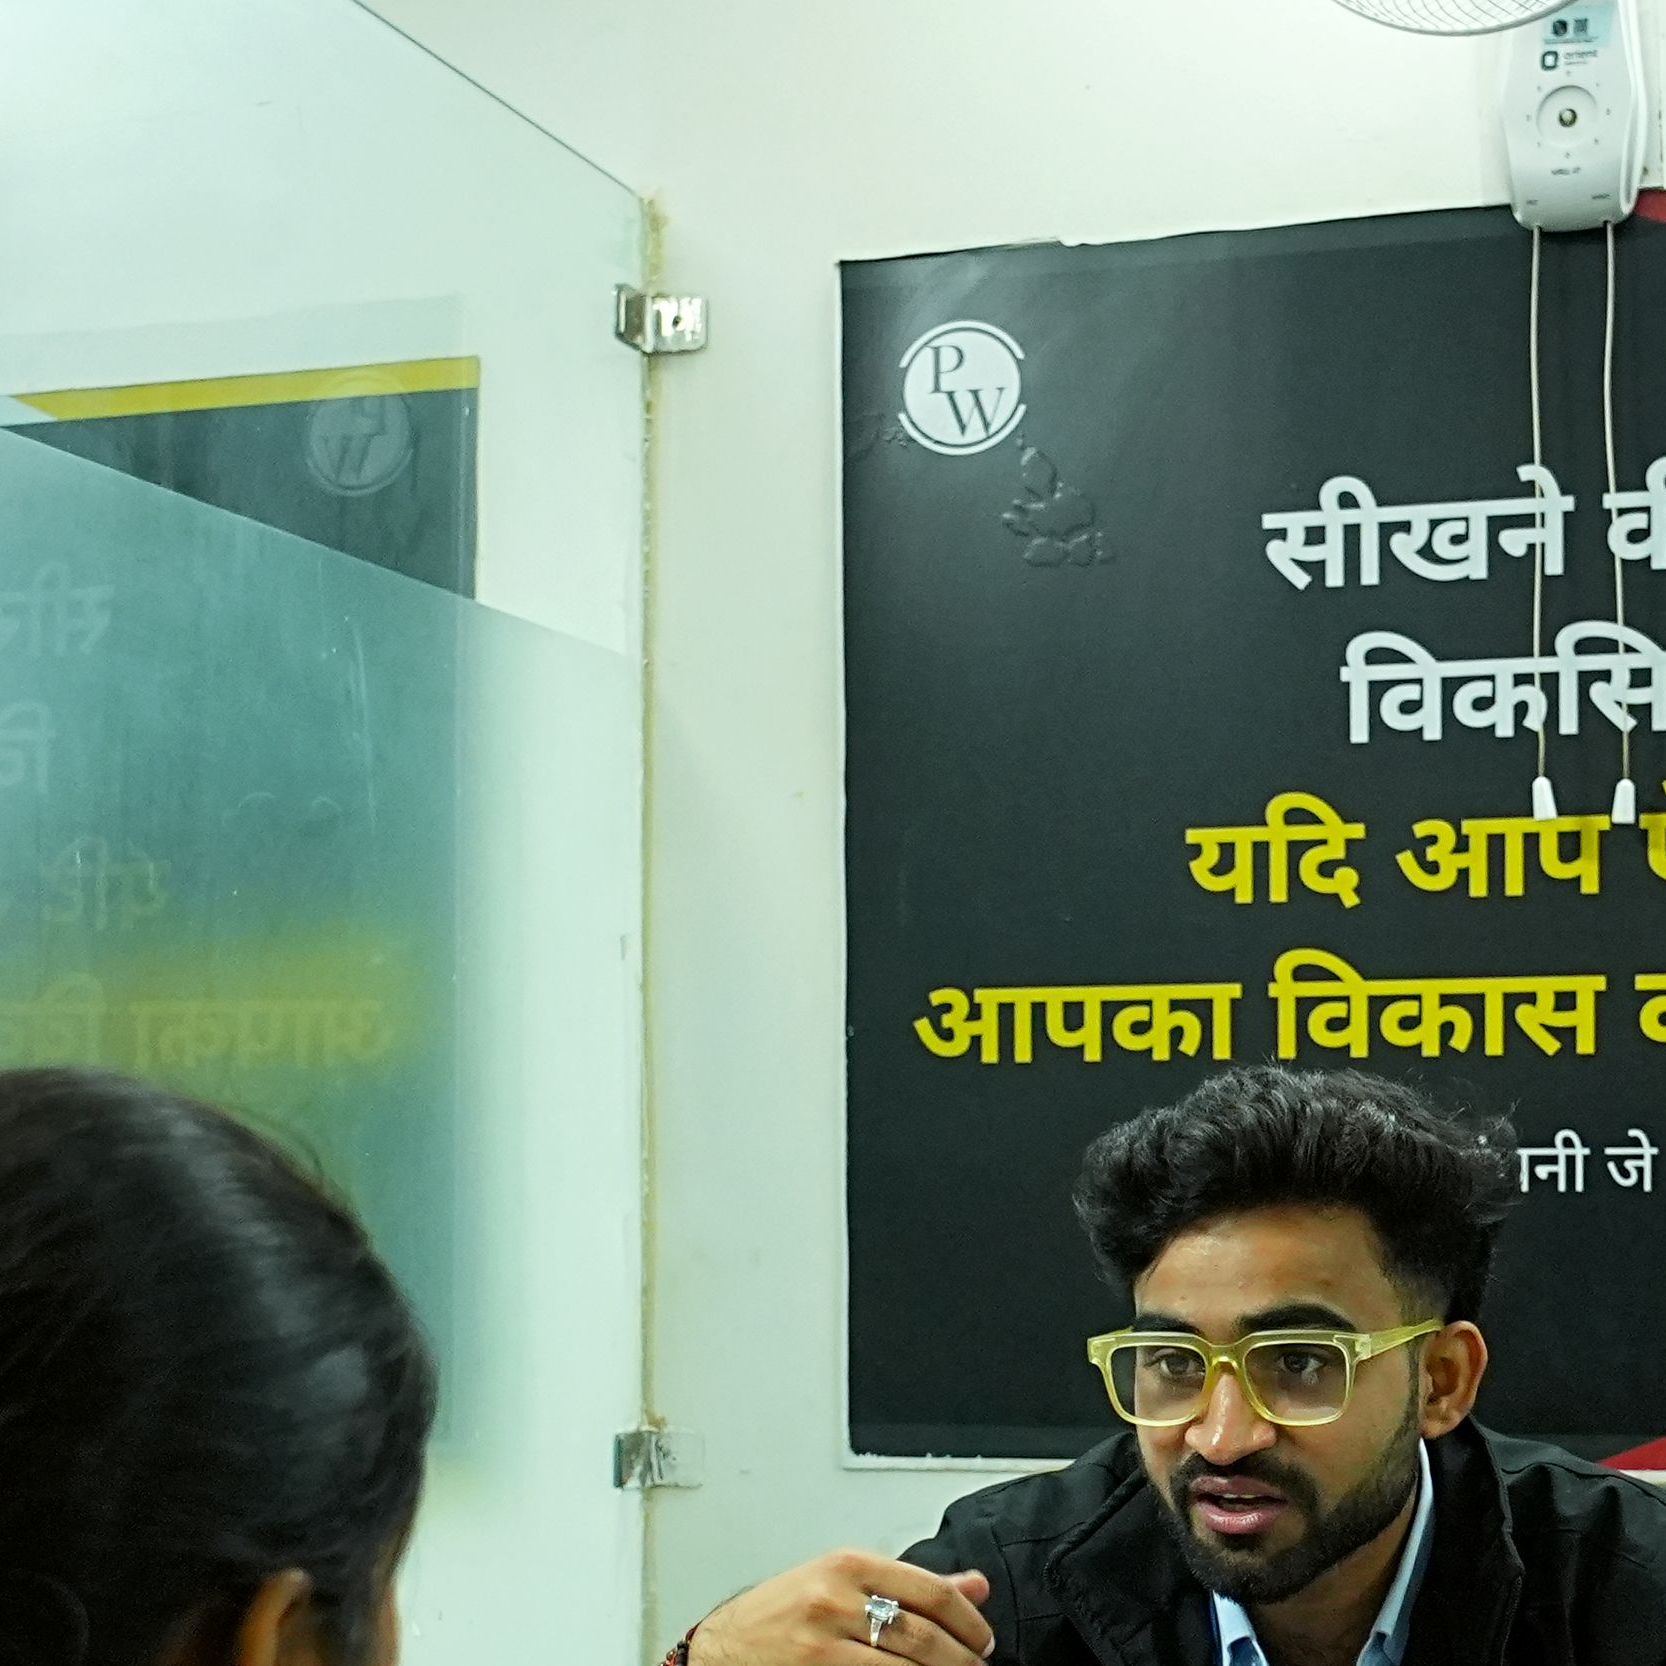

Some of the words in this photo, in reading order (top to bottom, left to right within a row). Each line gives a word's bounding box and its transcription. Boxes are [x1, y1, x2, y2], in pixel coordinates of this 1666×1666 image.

[1261, 463, 1572, 590] सीखने
[1185, 791, 1366, 908] यदि
[1396, 811, 1610, 898] आप
[914, 982, 1242, 1064] आपका
[1268, 948, 1606, 1060] विकास
[1604, 1128, 1659, 1193] जे
